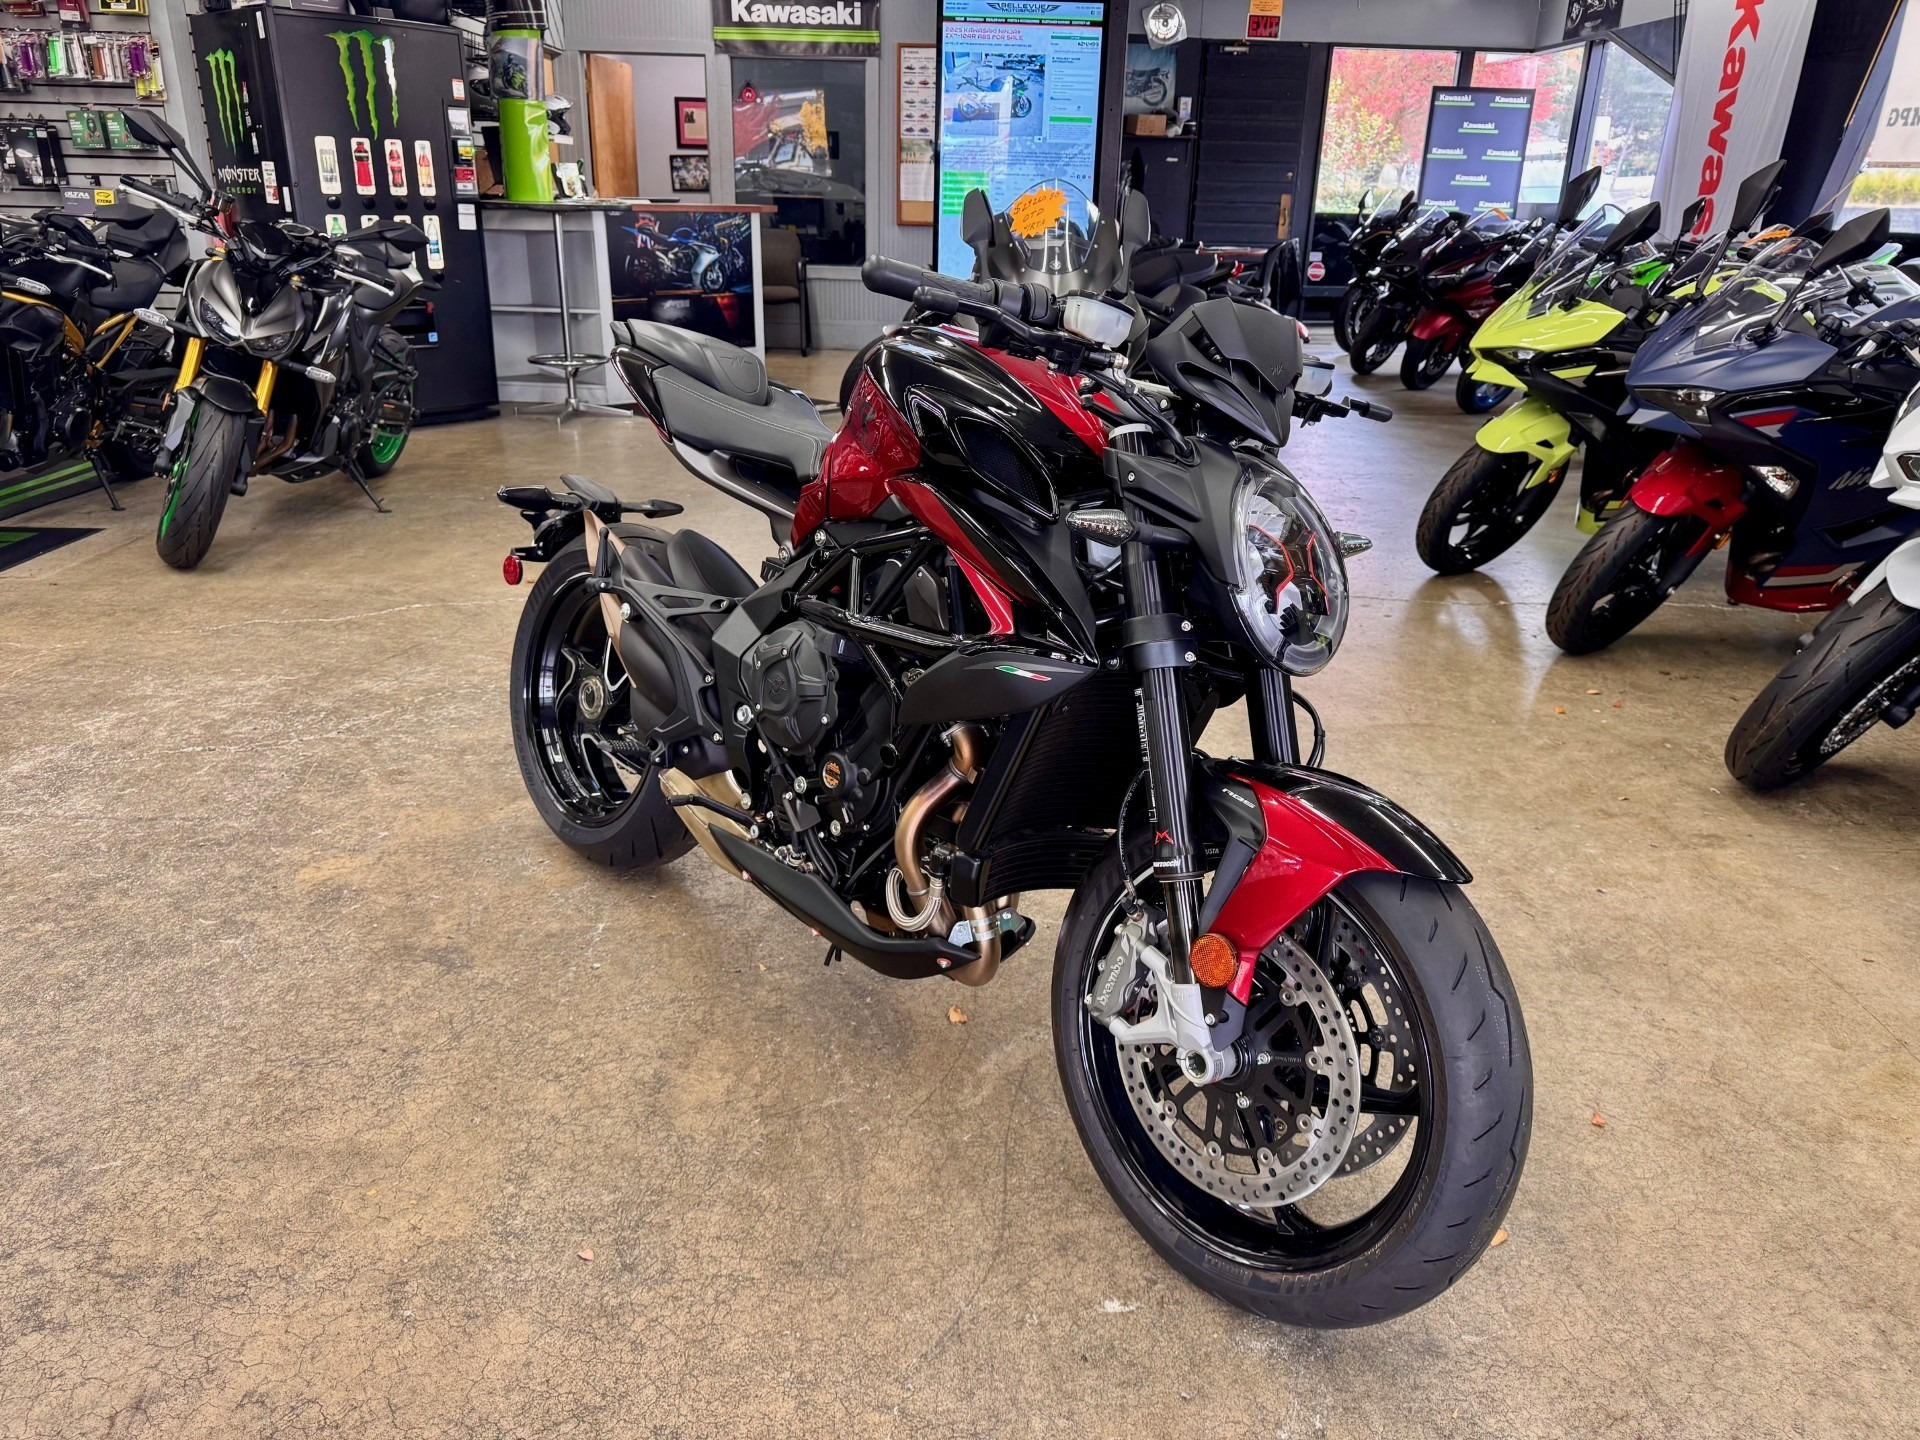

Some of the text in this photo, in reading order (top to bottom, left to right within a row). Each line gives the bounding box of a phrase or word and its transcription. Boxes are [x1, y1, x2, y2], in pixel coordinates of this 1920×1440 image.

[731, 0, 862, 25] Kawasaki
[1248, 16, 1279, 37] EXIT
[1439, 94, 1472, 102] Kawasaki
[1494, 95, 1527, 104] Kawasaki
[1462, 121, 1495, 130] Kawasaki
[1692, 0, 1765, 242] Kawas
[1431, 147, 1464, 155] Kawasaki
[1486, 148, 1519, 157] Kawasaki
[217, 165, 261, 183] MONSTER
[1455, 174, 1487, 182] Kawasaki
[226, 186, 257, 194] ENERGY
[1424, 198, 1456, 207] Kawasaki
[1478, 200, 1511, 208] Kawasaki
[1097, 956, 1125, 1007] brembo
